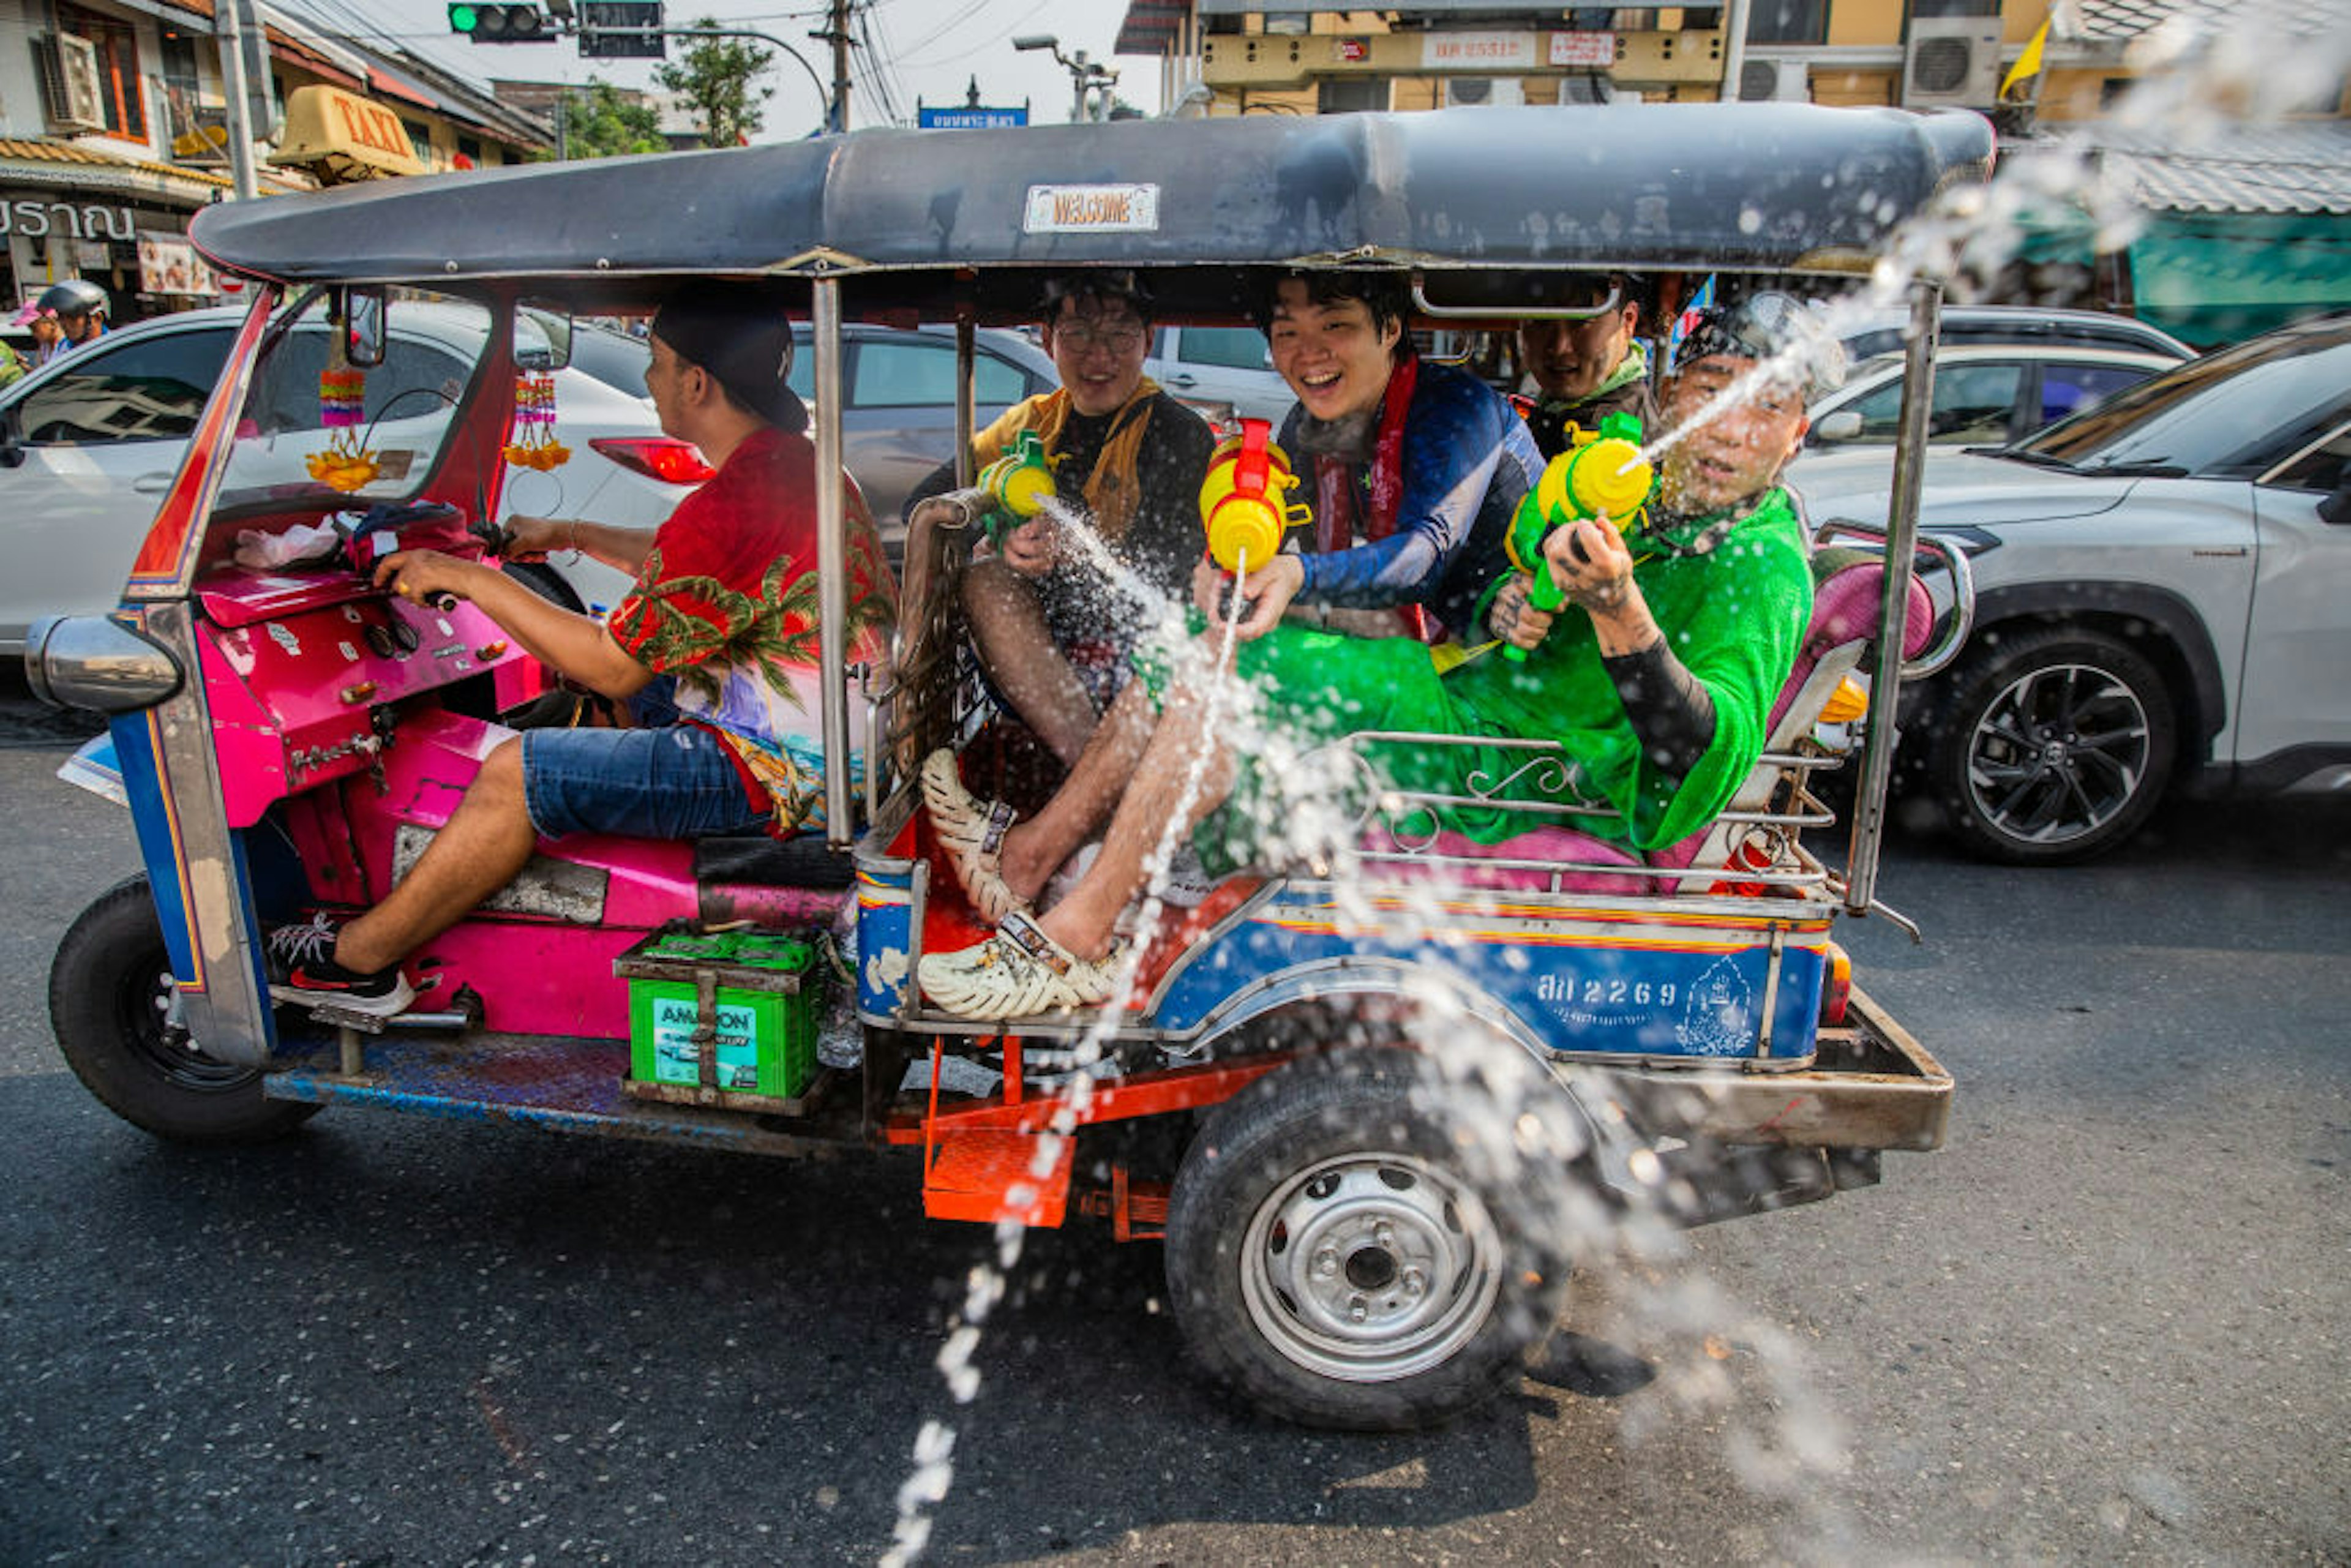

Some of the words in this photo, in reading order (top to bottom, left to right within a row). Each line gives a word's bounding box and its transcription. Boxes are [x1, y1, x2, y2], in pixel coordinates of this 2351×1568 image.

[332, 94, 410, 159] TAXI
[1054, 192, 1133, 225] WELCOME
[1583, 980, 1676, 1007] 2269
